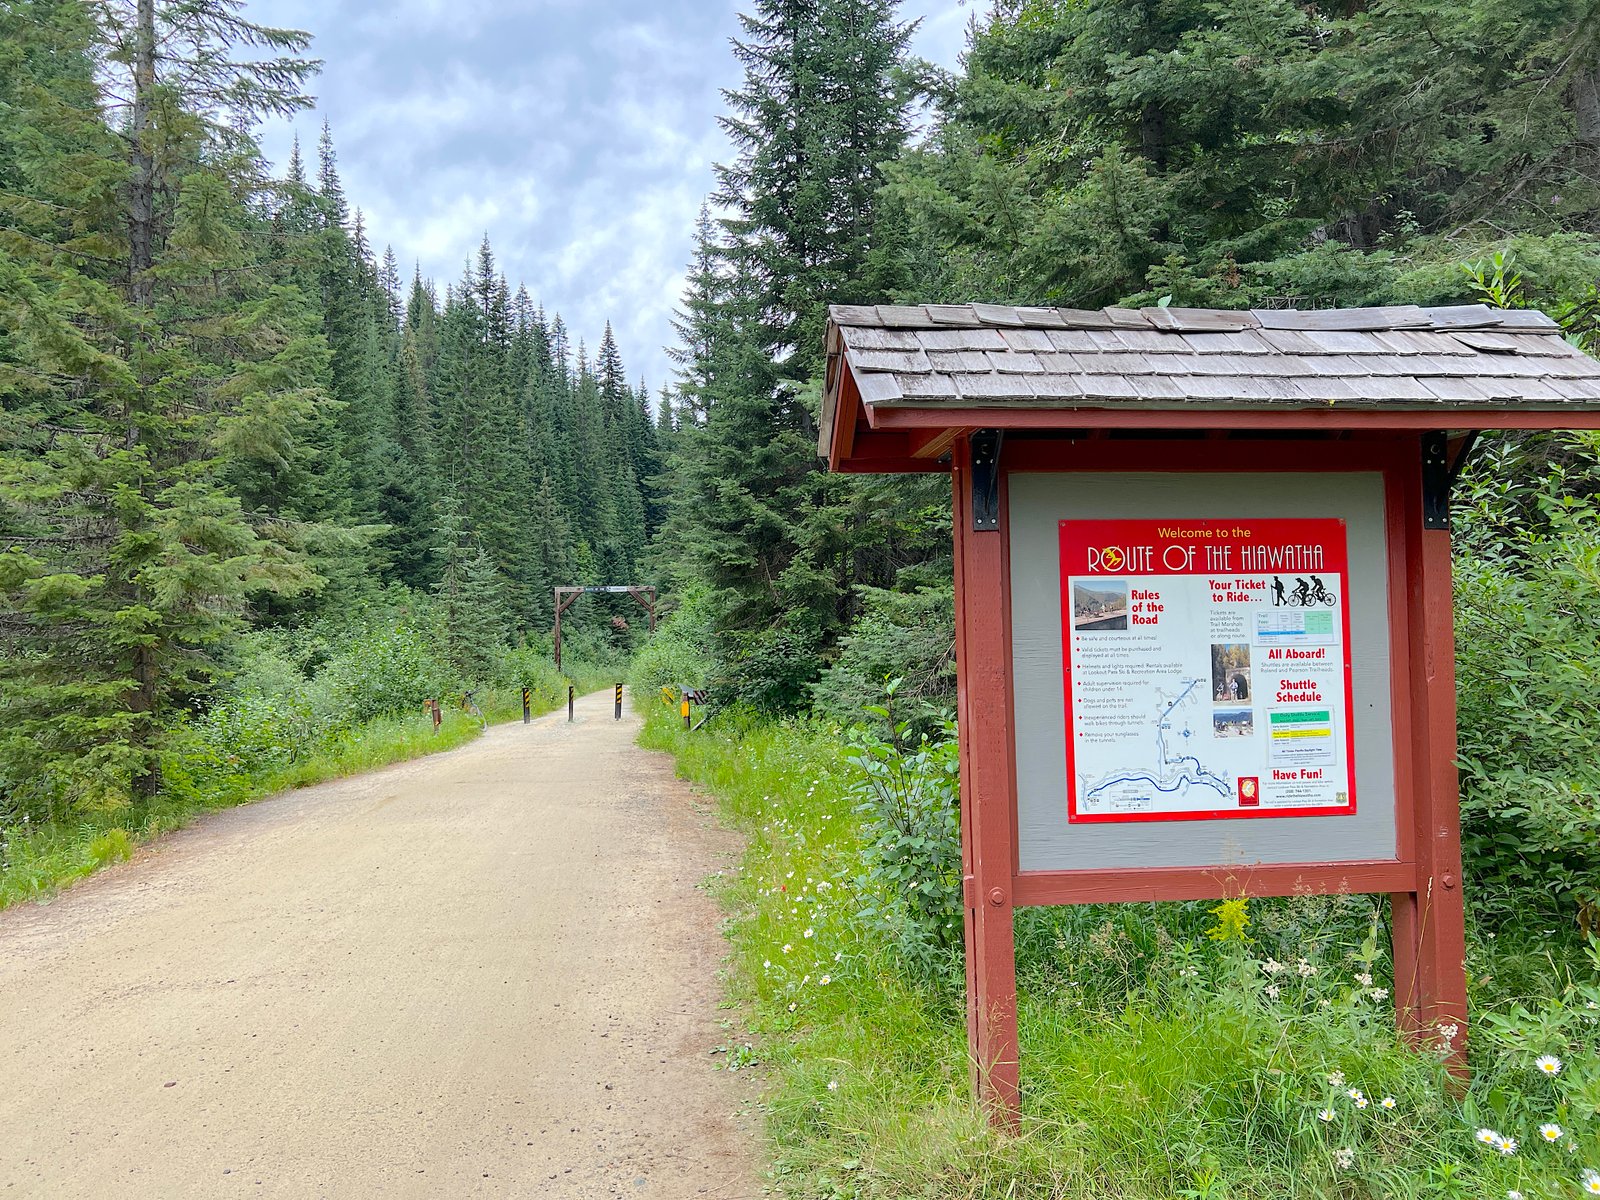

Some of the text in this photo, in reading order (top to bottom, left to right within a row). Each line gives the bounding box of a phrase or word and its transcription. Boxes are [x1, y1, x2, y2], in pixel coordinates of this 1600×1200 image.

[1157, 527, 1251, 538] Welcome to the
[1087, 544, 1324, 572] ROUTE OF THE HIAWATHA
[1208, 579, 1266, 590] Your Ticket
[1131, 590, 1160, 600] Rules
[1212, 592, 1262, 602] to Ride...
[1132, 602, 1164, 612] of the
[1132, 614, 1159, 625] Road
[1268, 648, 1325, 659] All Aboard!
[1280, 679, 1317, 690] Shuttle
[1276, 691, 1322, 702] Schedule
[1273, 768, 1323, 780] Have Fun!
